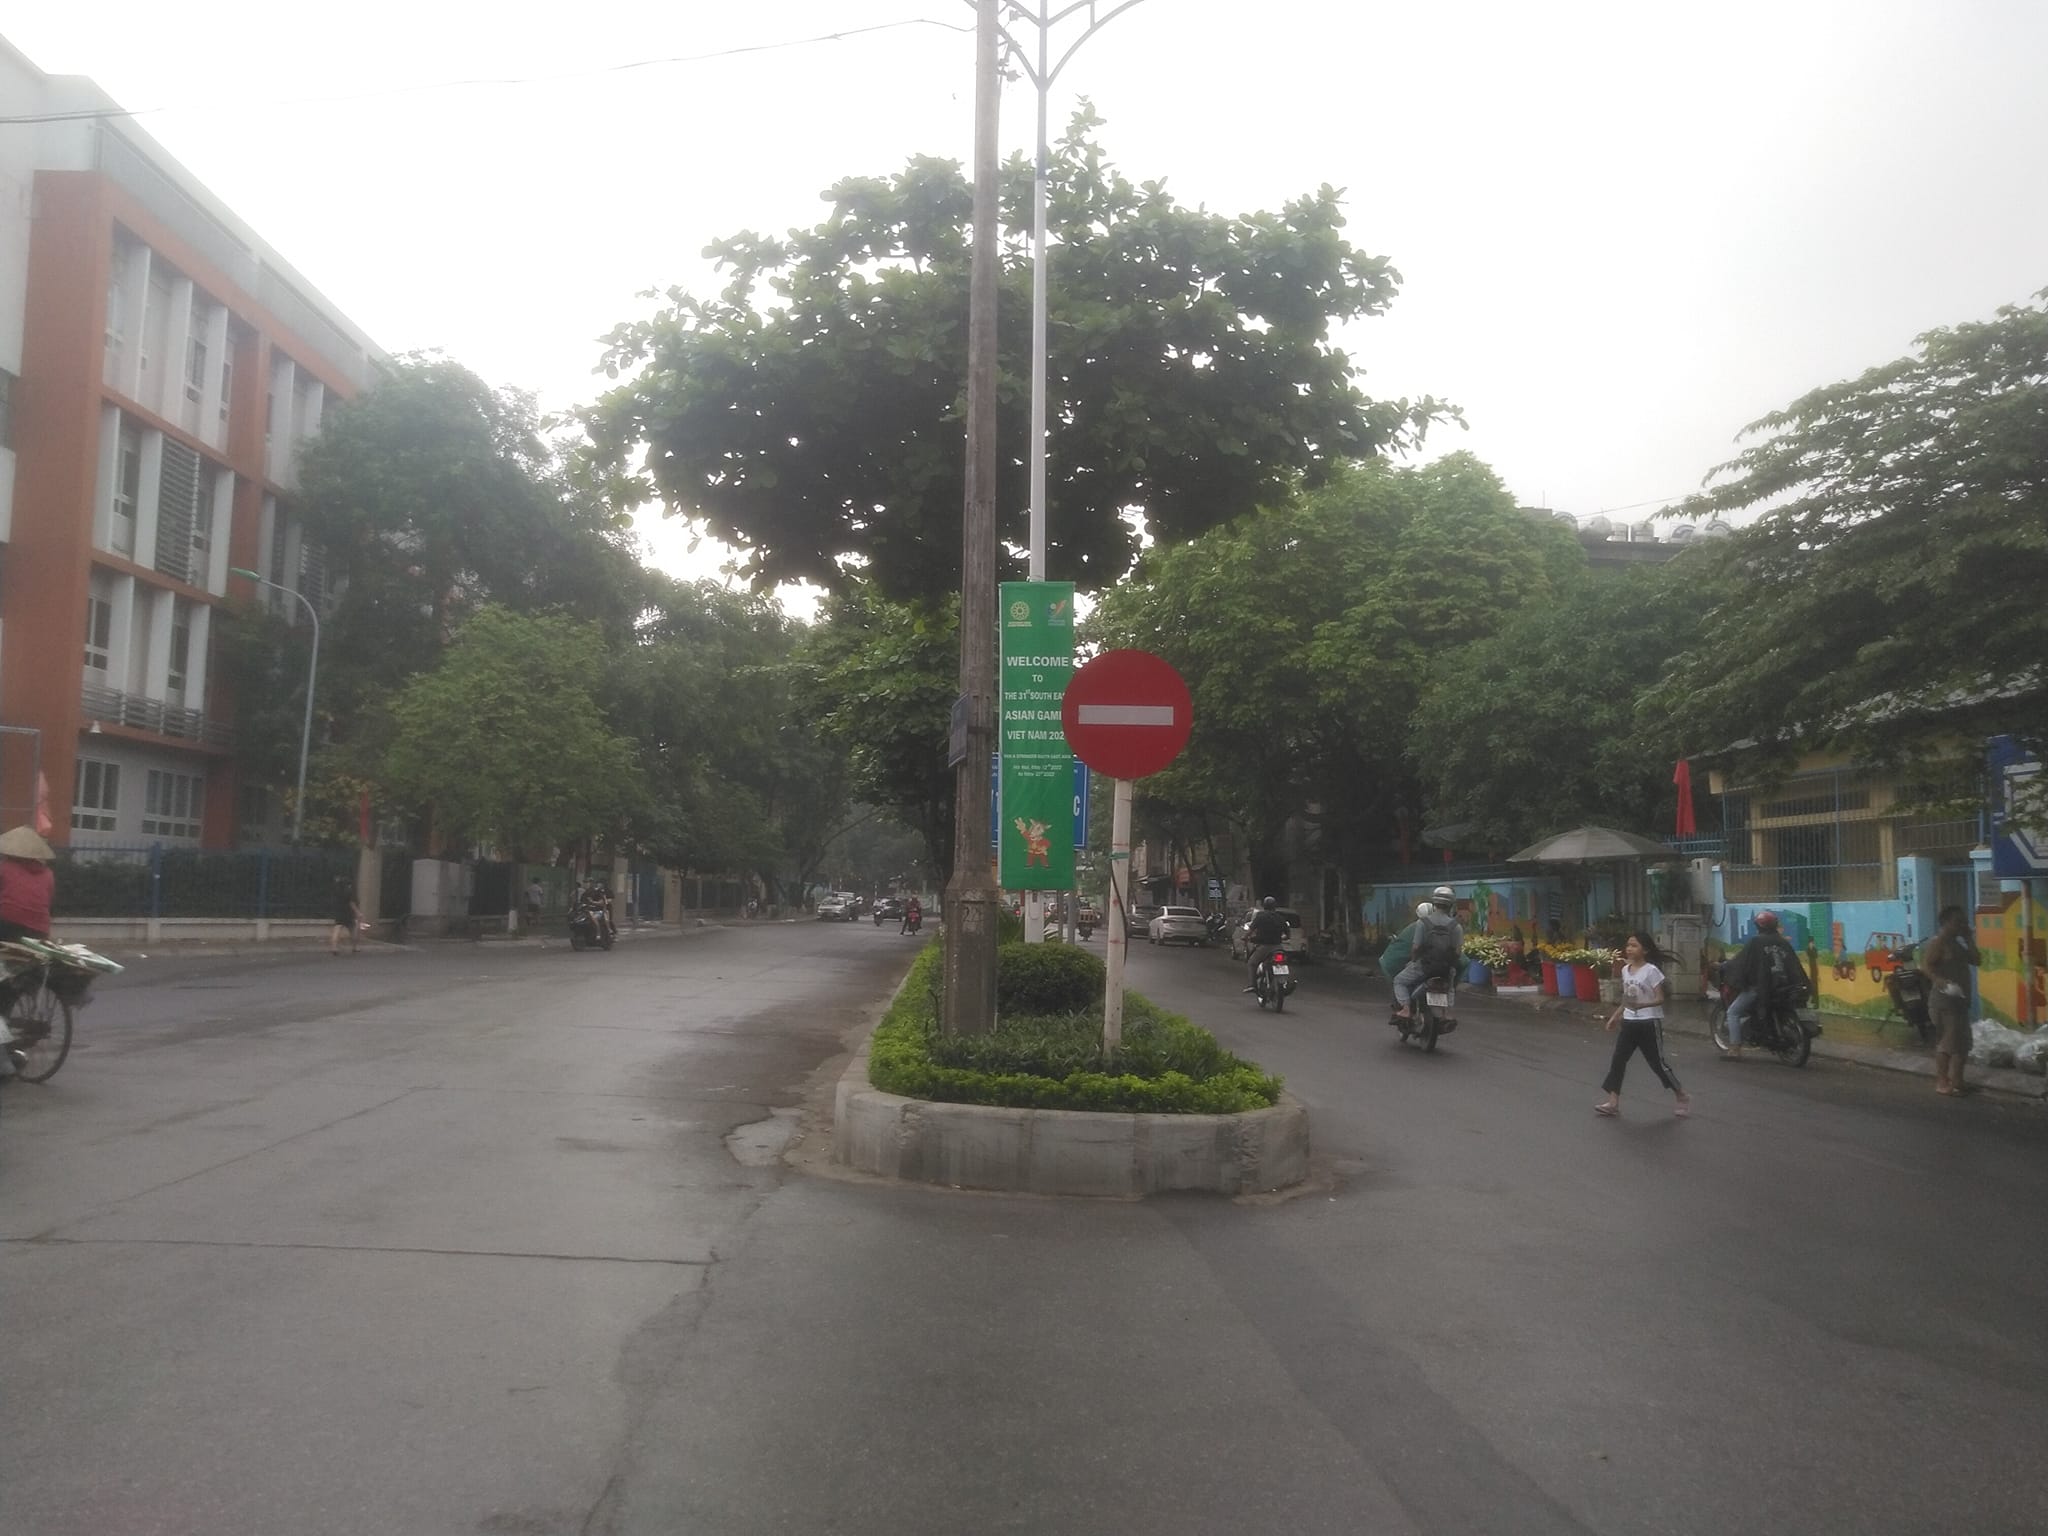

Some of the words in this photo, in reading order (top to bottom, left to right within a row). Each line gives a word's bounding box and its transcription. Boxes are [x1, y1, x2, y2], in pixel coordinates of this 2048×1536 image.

[1007, 656, 1069, 667] WELCOME
[1032, 674, 1043, 682] TO
[1004, 692, 1017, 700] THE
[1030, 691, 1052, 700] SOUTH
[1053, 691, 1065, 700] EA
[1005, 710, 1035, 720] ASIAN
[1007, 730, 1026, 740] VIET
[1027, 730, 1047, 740] NAM
